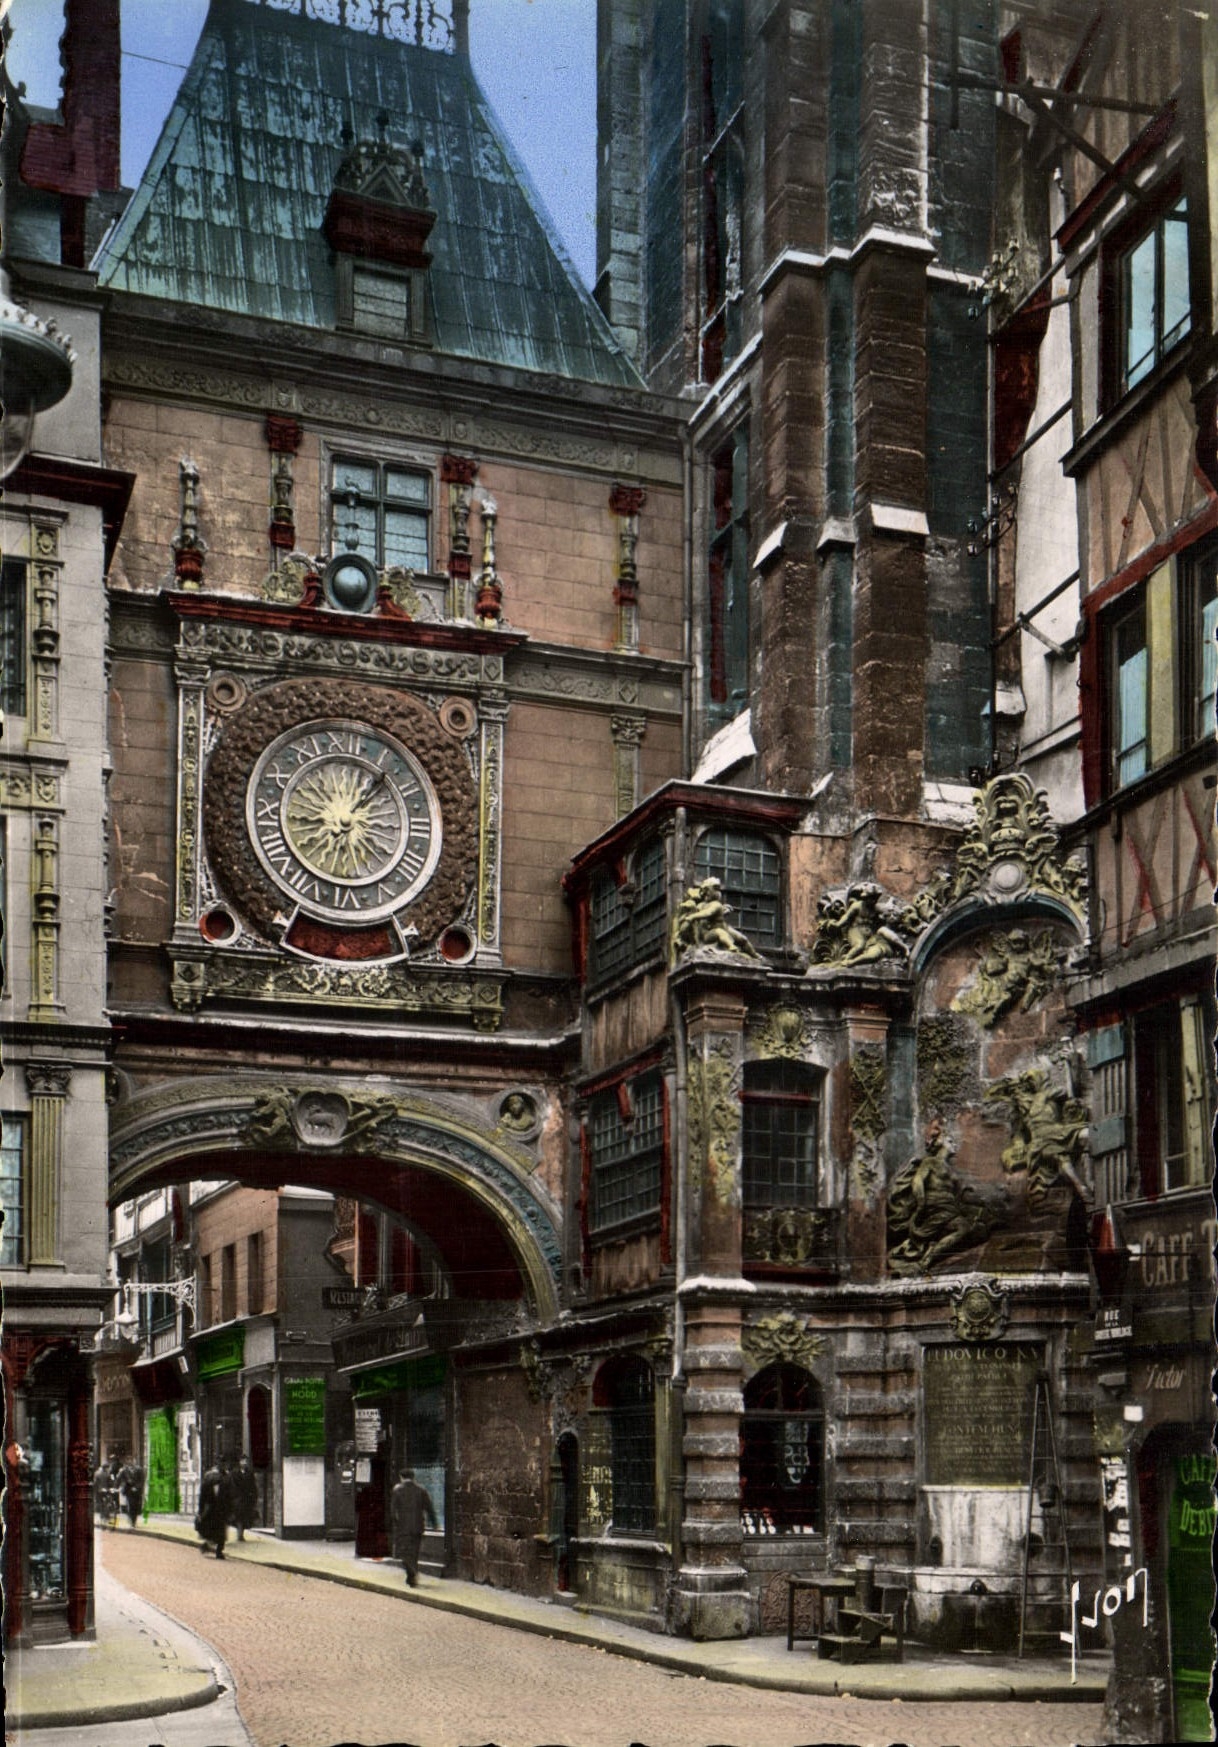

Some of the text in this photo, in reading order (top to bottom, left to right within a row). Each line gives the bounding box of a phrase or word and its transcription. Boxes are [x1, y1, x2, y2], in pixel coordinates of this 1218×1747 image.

[289, 735, 322, 765] XI
[325, 731, 361, 755] XII
[376, 748, 389, 766] I
[266, 762, 291, 789] X
[399, 781, 420, 798] II
[257, 797, 280, 827] IX
[409, 817, 431, 839] III
[261, 832, 292, 876] VIII
[396, 850, 426, 882] IIII
[289, 869, 321, 902] VII
[334, 886, 361, 909] VI
[376, 883, 396, 904] V
